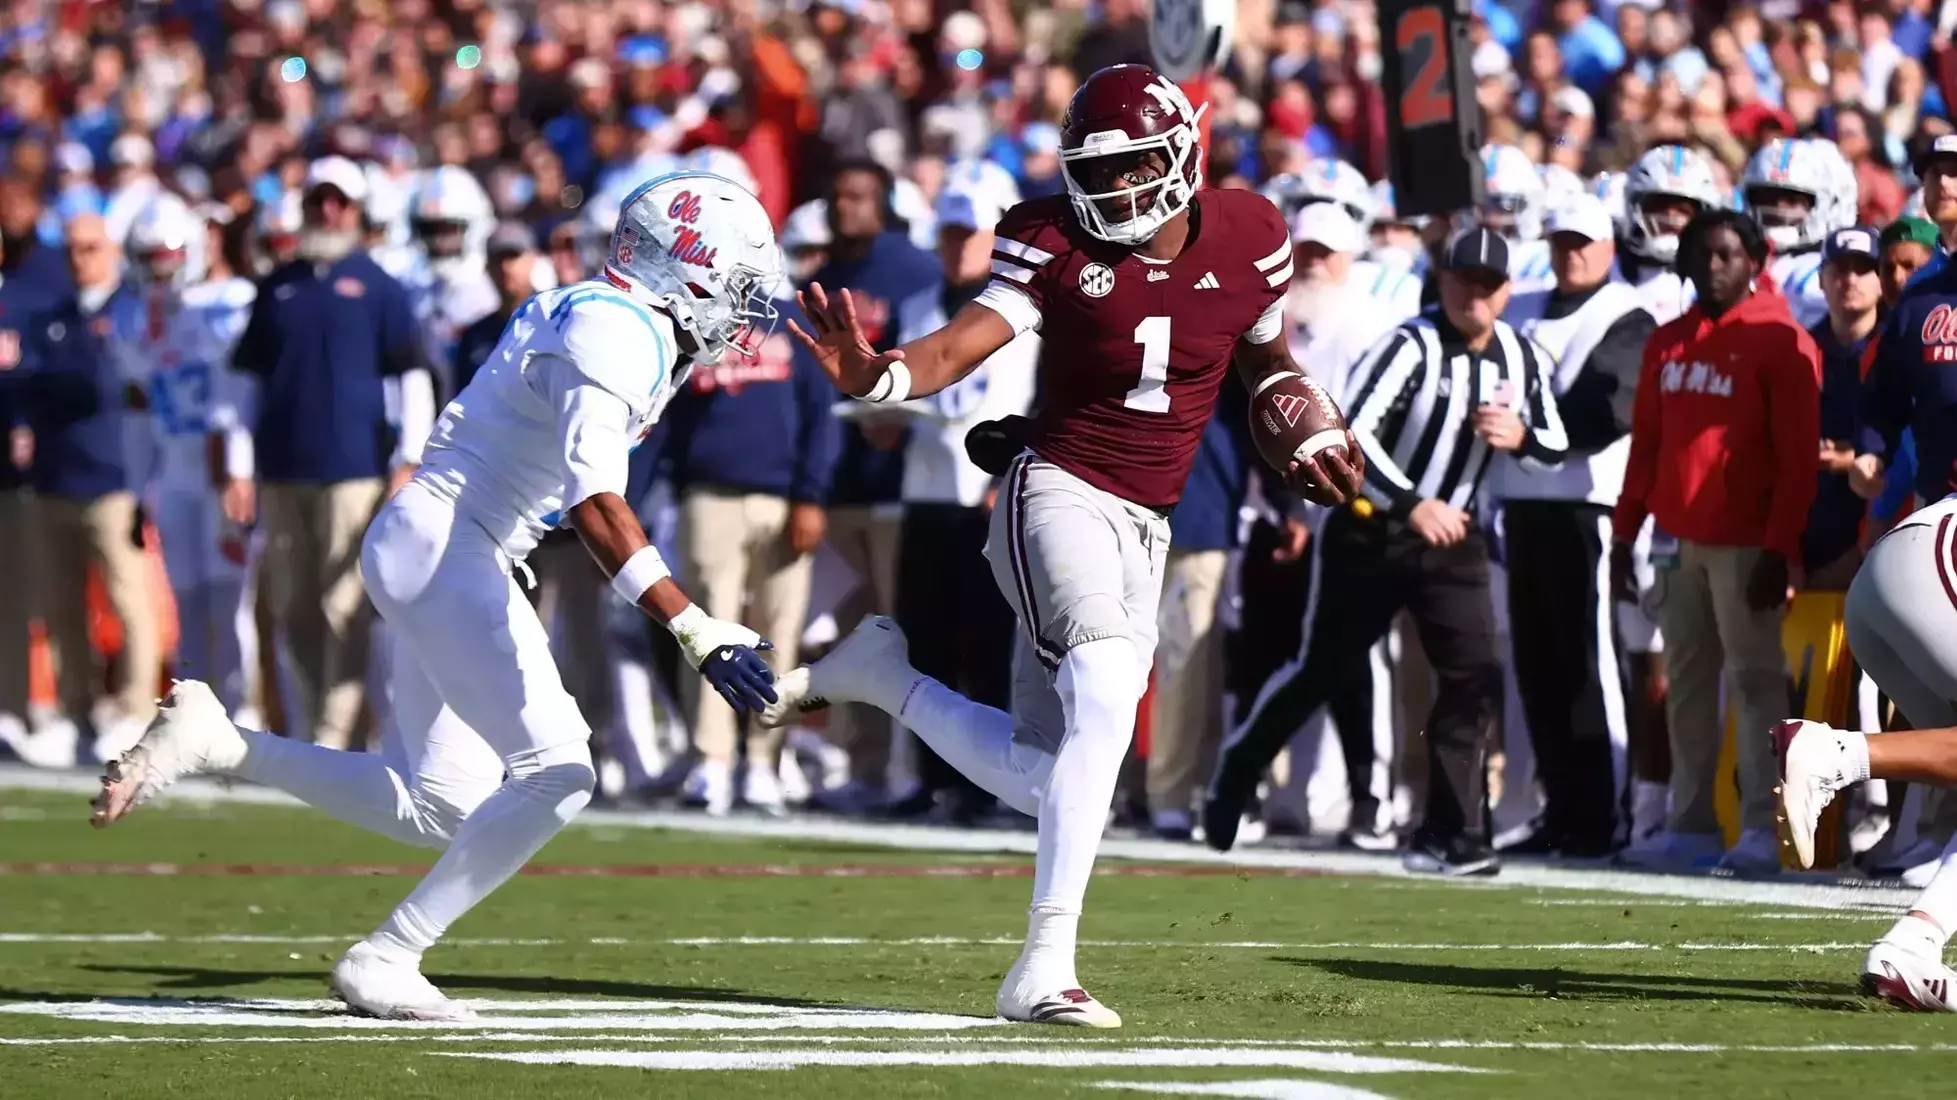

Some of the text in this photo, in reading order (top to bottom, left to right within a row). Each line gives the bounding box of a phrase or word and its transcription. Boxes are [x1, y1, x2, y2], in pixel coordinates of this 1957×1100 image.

[1396, 7, 1453, 127] 2
[1123, 172, 1153, 184] BABY
[668, 190, 702, 224] Ole
[668, 225, 718, 267] Miss
[1081, 263, 1112, 296] SEC
[1123, 316, 1171, 413] 1
